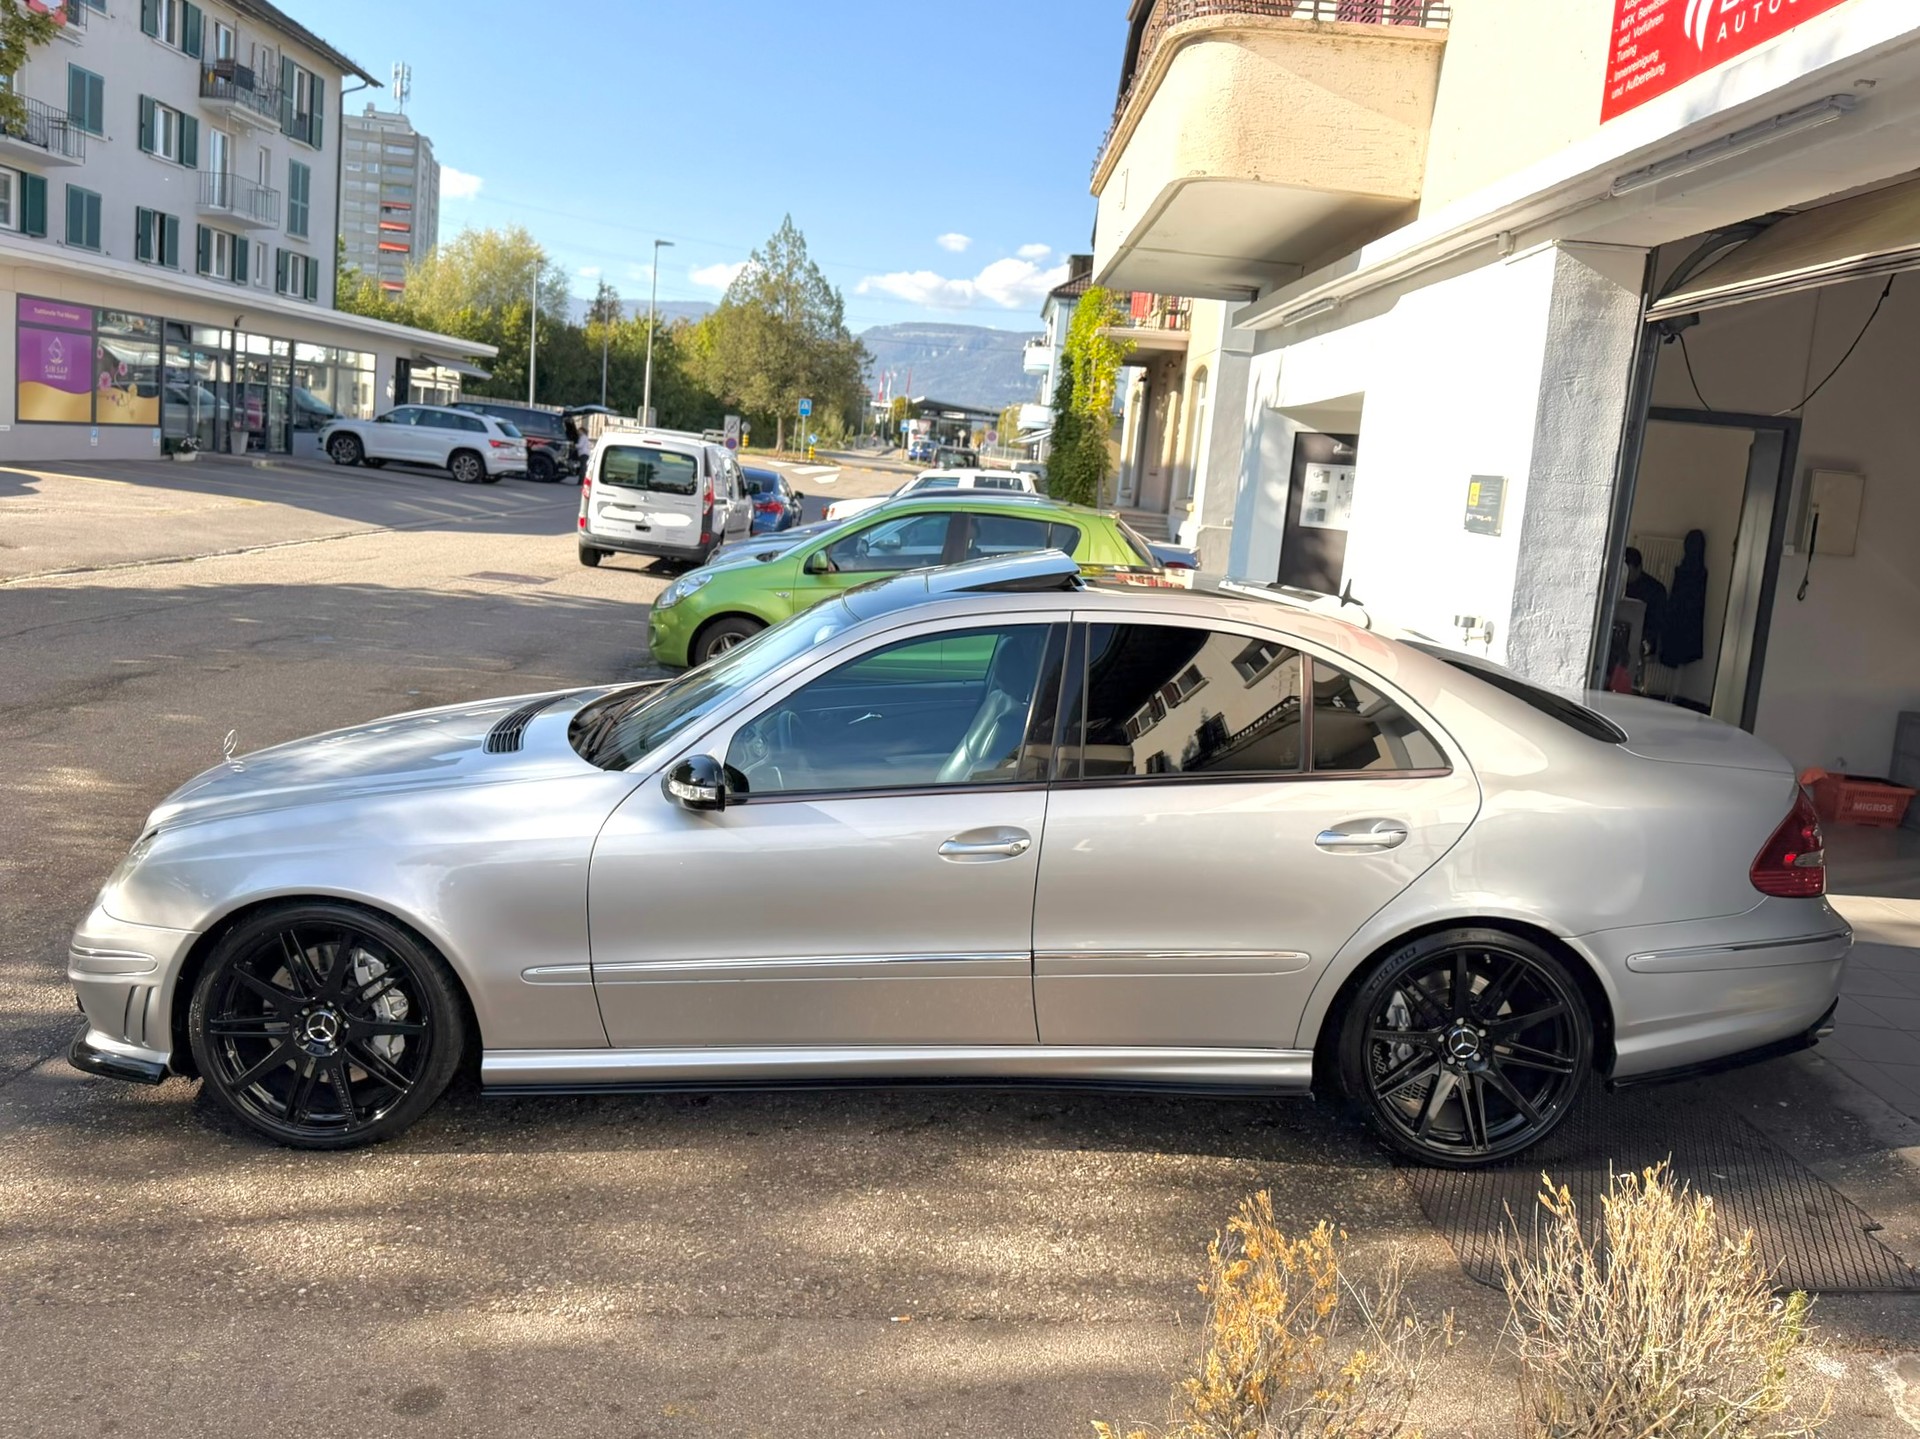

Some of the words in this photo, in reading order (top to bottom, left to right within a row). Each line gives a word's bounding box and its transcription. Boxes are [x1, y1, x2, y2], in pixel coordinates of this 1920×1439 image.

[1618, 31, 1631, 48] und
[1633, 13, 1665, 38] Vorführen
[1716, 0, 1798, 43] AUTO
[1613, 49, 1660, 82] Innenreinigung
[1617, 44, 1638, 63] Tuning
[1611, 84, 1624, 99] und
[1625, 62, 1667, 92] Aufbereitung
[1853, 801, 1894, 813] MIGROS
